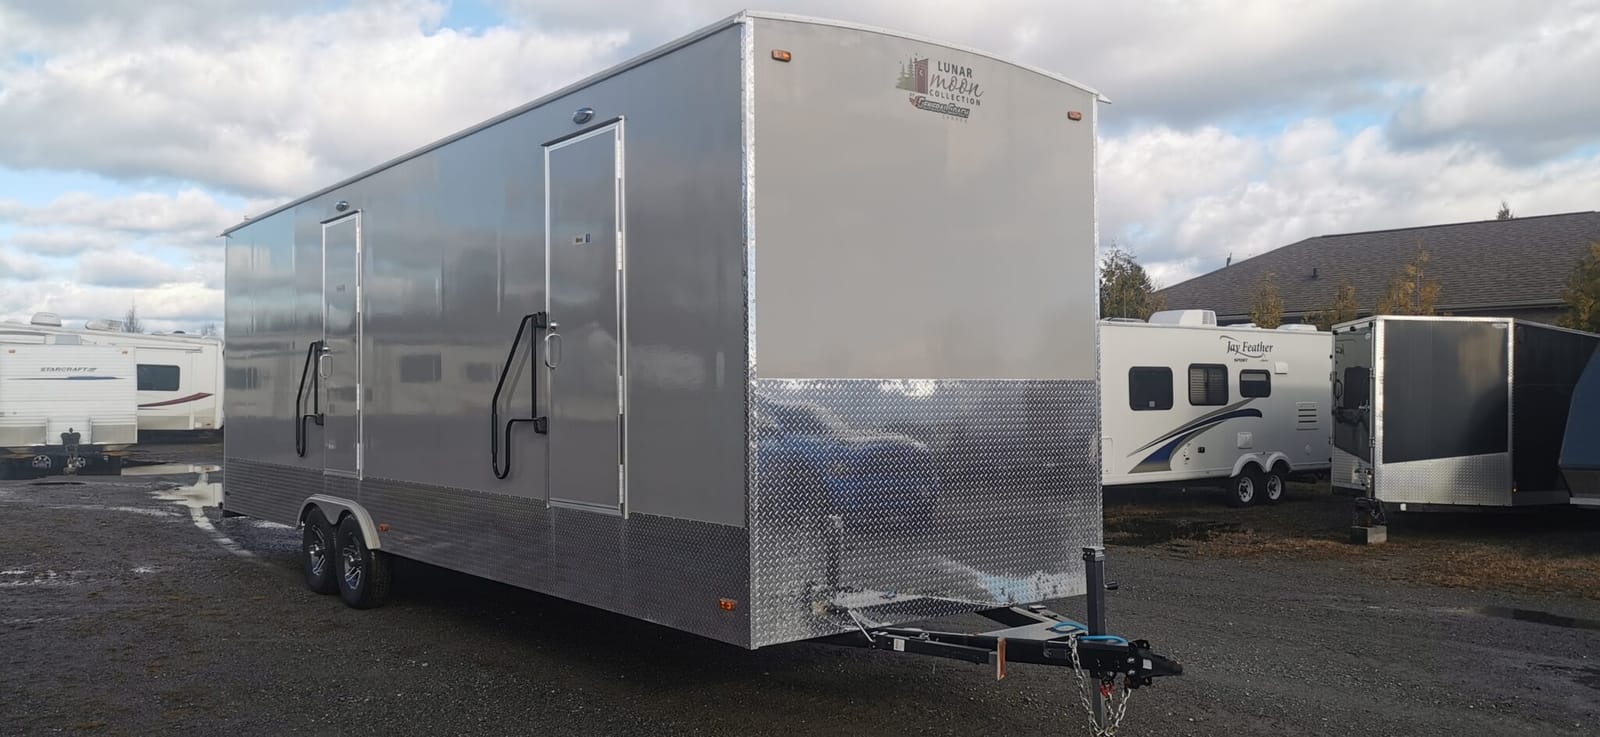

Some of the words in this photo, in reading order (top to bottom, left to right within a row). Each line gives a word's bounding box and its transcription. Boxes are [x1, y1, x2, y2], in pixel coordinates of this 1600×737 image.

[937, 60, 973, 78] LUNAR
[929, 73, 984, 98] moon
[929, 89, 981, 106] COLLECTION
[1227, 341, 1241, 355] Jay
[1242, 341, 1274, 353] Feather
